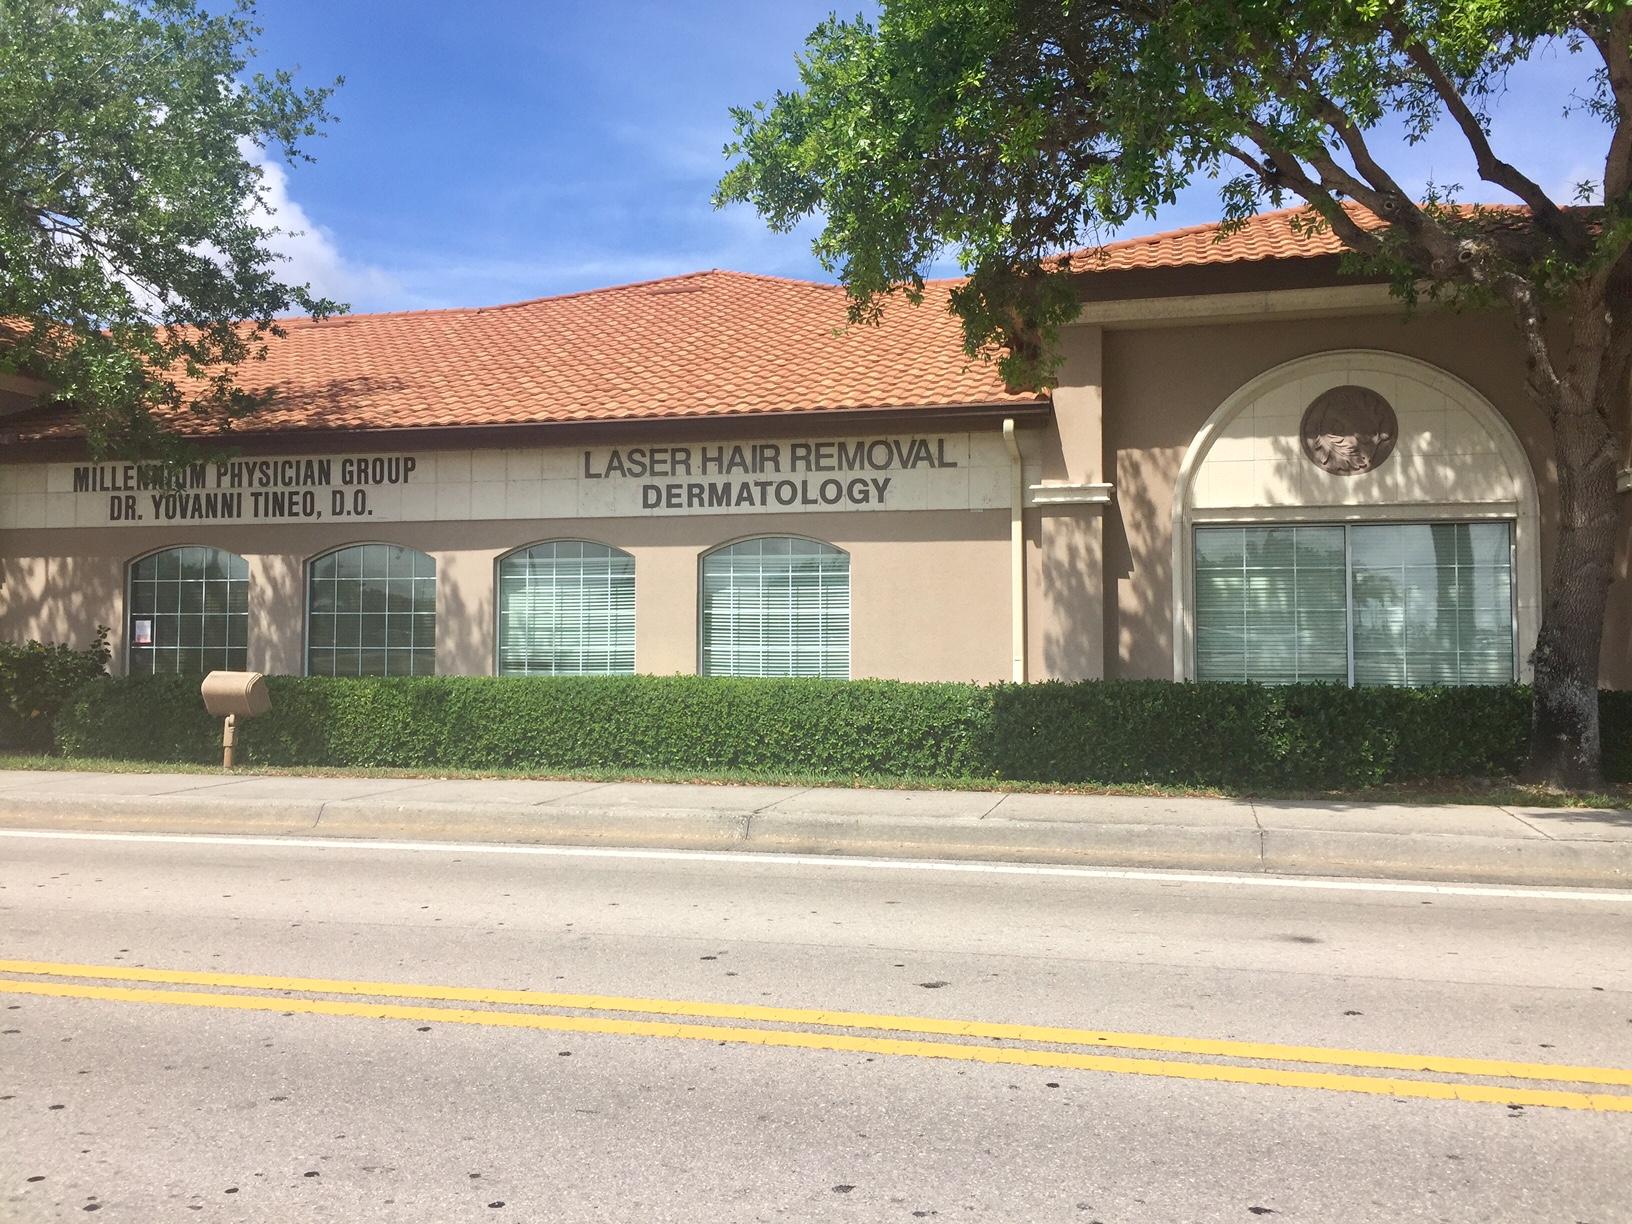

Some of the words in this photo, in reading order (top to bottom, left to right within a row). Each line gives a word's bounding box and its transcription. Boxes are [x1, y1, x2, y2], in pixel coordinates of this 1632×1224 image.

[216, 459, 331, 488] PHYSICIAN
[341, 457, 416, 485] GROUP
[584, 447, 692, 479] LASER
[702, 444, 781, 475] HAIR
[791, 438, 958, 472] REMOVAL
[110, 495, 143, 520] DR.
[151, 492, 242, 520] YOVANNI
[250, 490, 322, 520] TINEO,
[331, 489, 373, 516] D.O.
[642, 478, 892, 509] DERMATOLOGY
